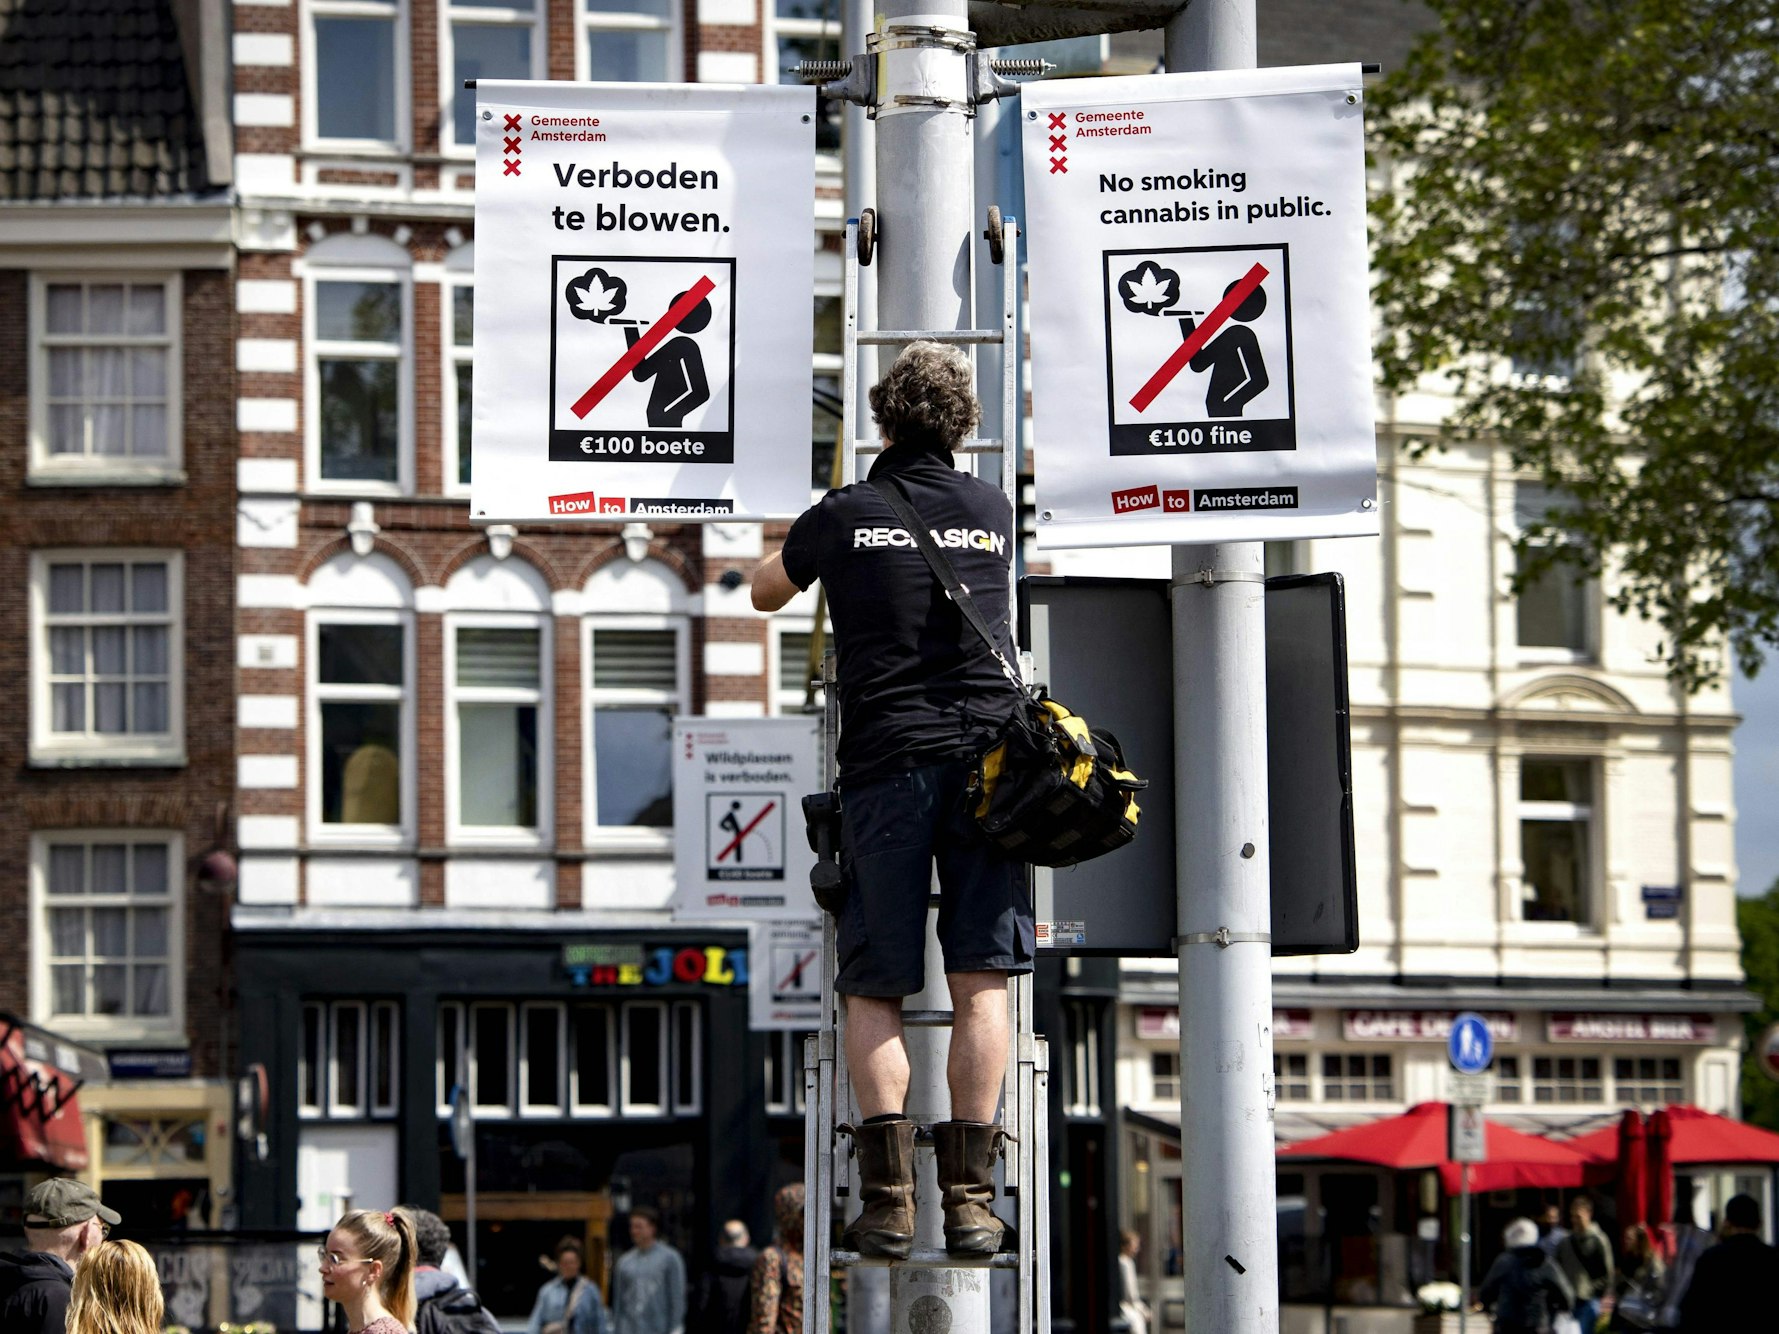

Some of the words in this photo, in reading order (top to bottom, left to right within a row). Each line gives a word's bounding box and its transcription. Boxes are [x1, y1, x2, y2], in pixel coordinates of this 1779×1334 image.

[530, 115, 600, 127] Gemeente
[1075, 110, 1144, 123] Gemeente
[530, 130, 606, 142] Amsterdam
[1075, 124, 1152, 138] Amsterdam
[553, 161, 718, 190] Verboden
[1100, 174, 1134, 193] No
[1141, 168, 1247, 193] smoking
[552, 206, 585, 231] te
[596, 203, 730, 233] blowen.
[1100, 201, 1210, 225] cannabis
[1217, 200, 1239, 220] in
[1247, 196, 1332, 224] public.
[580, 436, 635, 454] €100
[641, 436, 706, 455] boete
[1149, 428, 1204, 447] €100
[1209, 426, 1252, 445] fine
[553, 499, 591, 514] How
[603, 503, 622, 514] to
[635, 502, 730, 514] Amsterdam
[1117, 493, 1154, 510] How
[1167, 495, 1186, 509] to
[1198, 491, 1295, 508] Amsterdam
